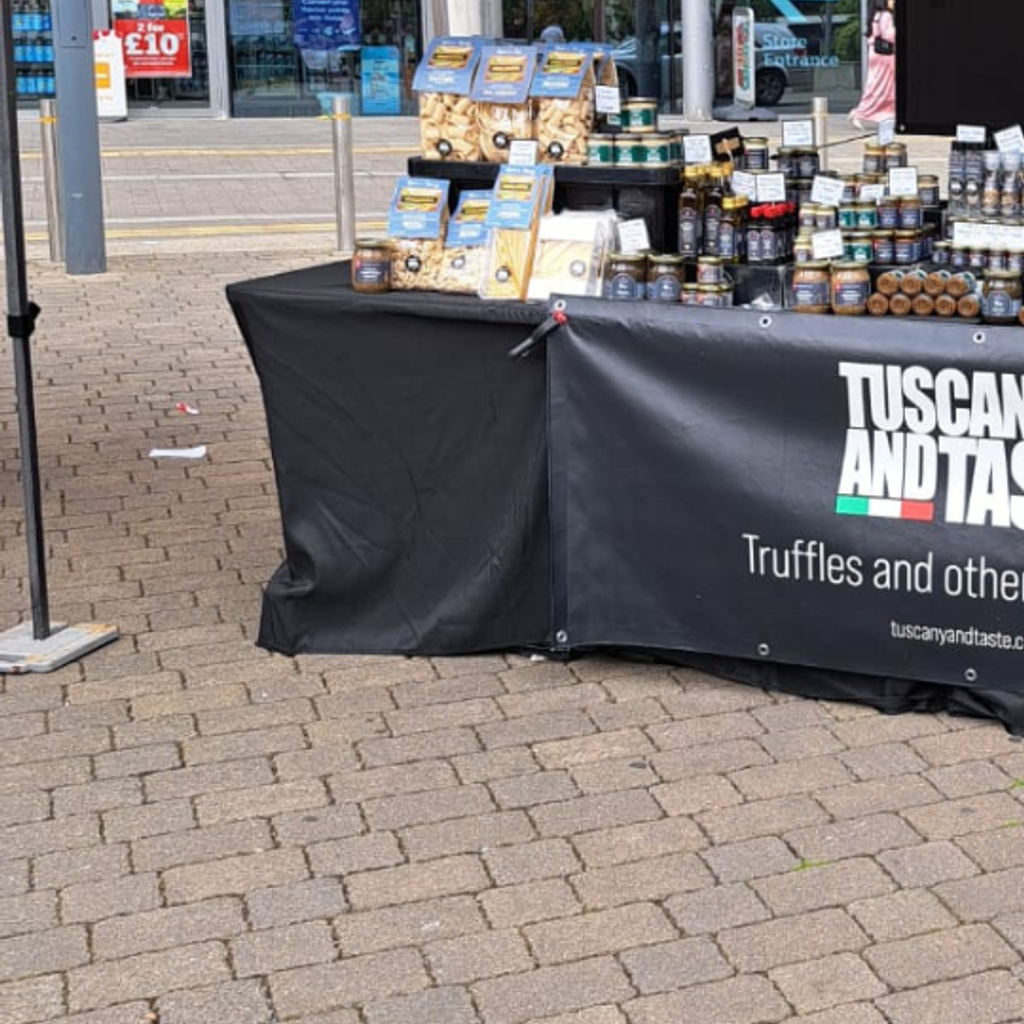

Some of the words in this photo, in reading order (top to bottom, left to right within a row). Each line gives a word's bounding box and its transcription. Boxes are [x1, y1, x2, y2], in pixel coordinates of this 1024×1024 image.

[125, 32, 179, 56] £10
[763, 33, 807, 49] Store
[764, 53, 839, 68] Entrance
[742, 532, 864, 587] Truffles
[873, 551, 933, 594] and
